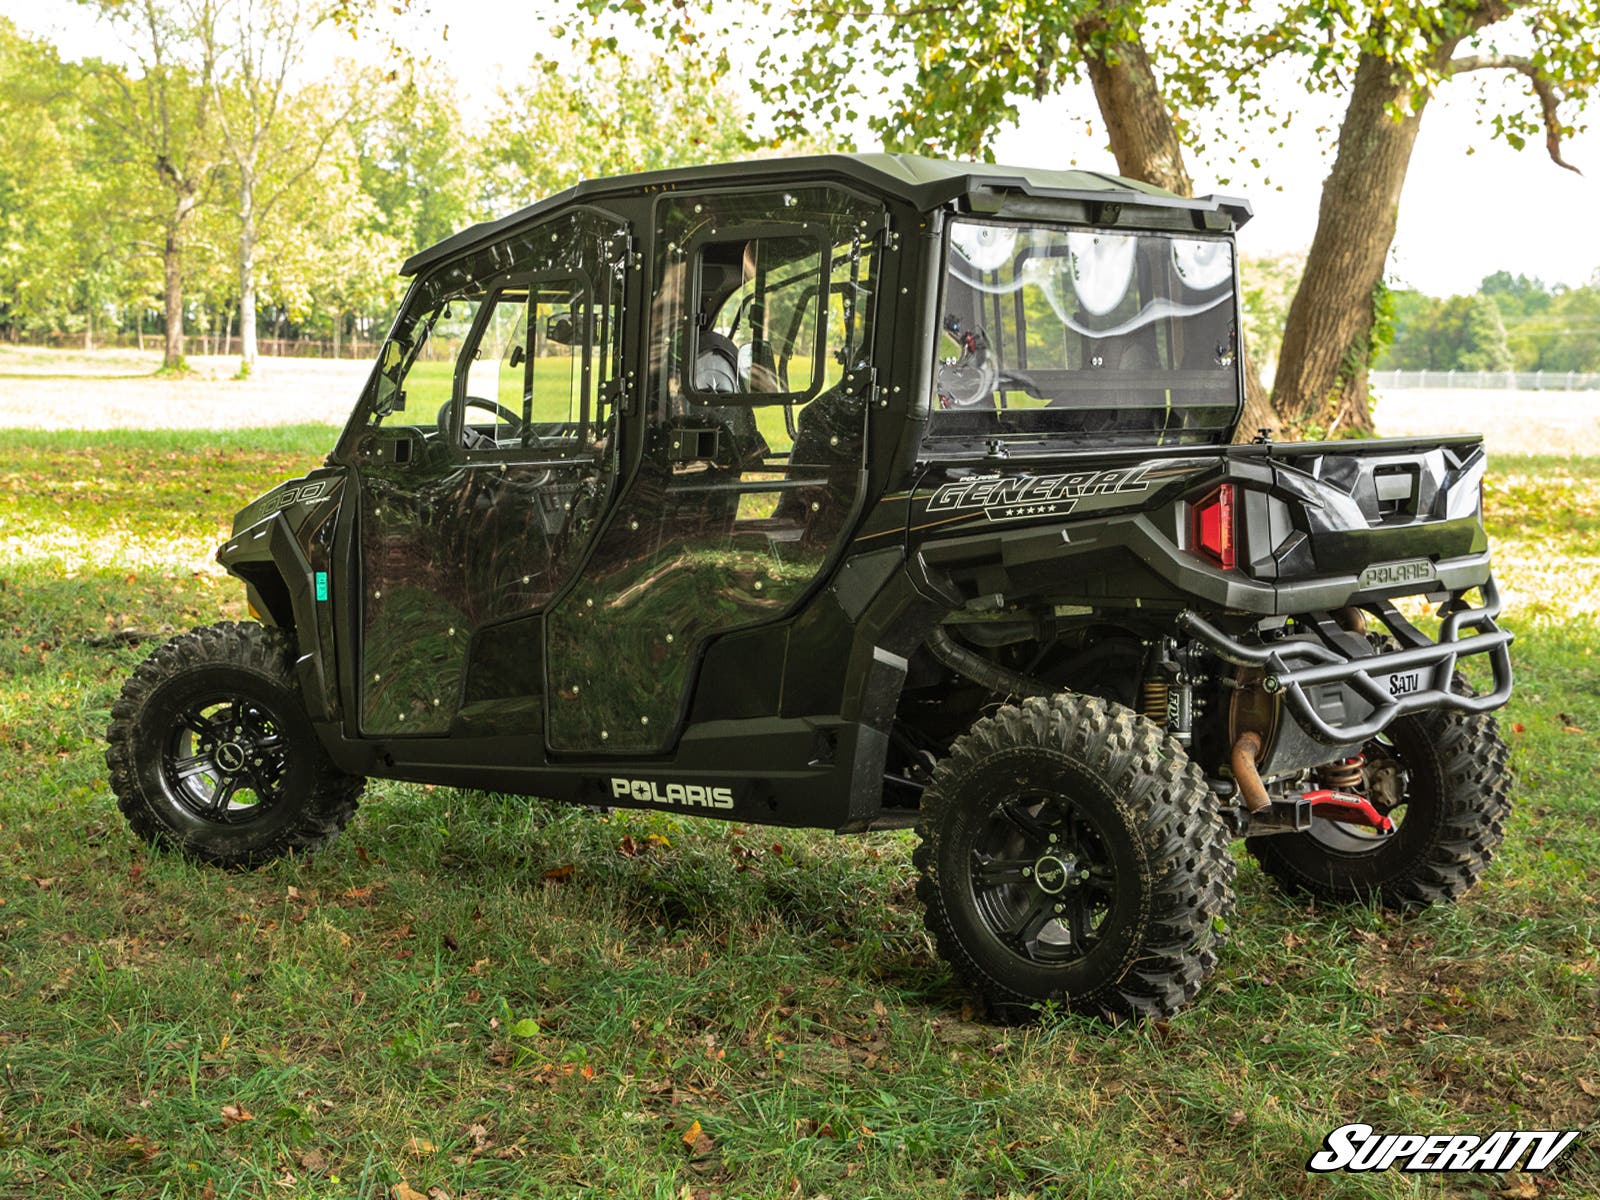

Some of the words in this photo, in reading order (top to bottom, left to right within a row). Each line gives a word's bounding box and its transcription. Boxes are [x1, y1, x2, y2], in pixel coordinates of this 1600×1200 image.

[926, 466, 1151, 512] GENERAL
[959, 474, 1000, 482] POLARIS
[1366, 562, 1429, 585] POLARIS
[1390, 673, 1418, 695] SATV
[611, 778, 734, 809] POLARIS
